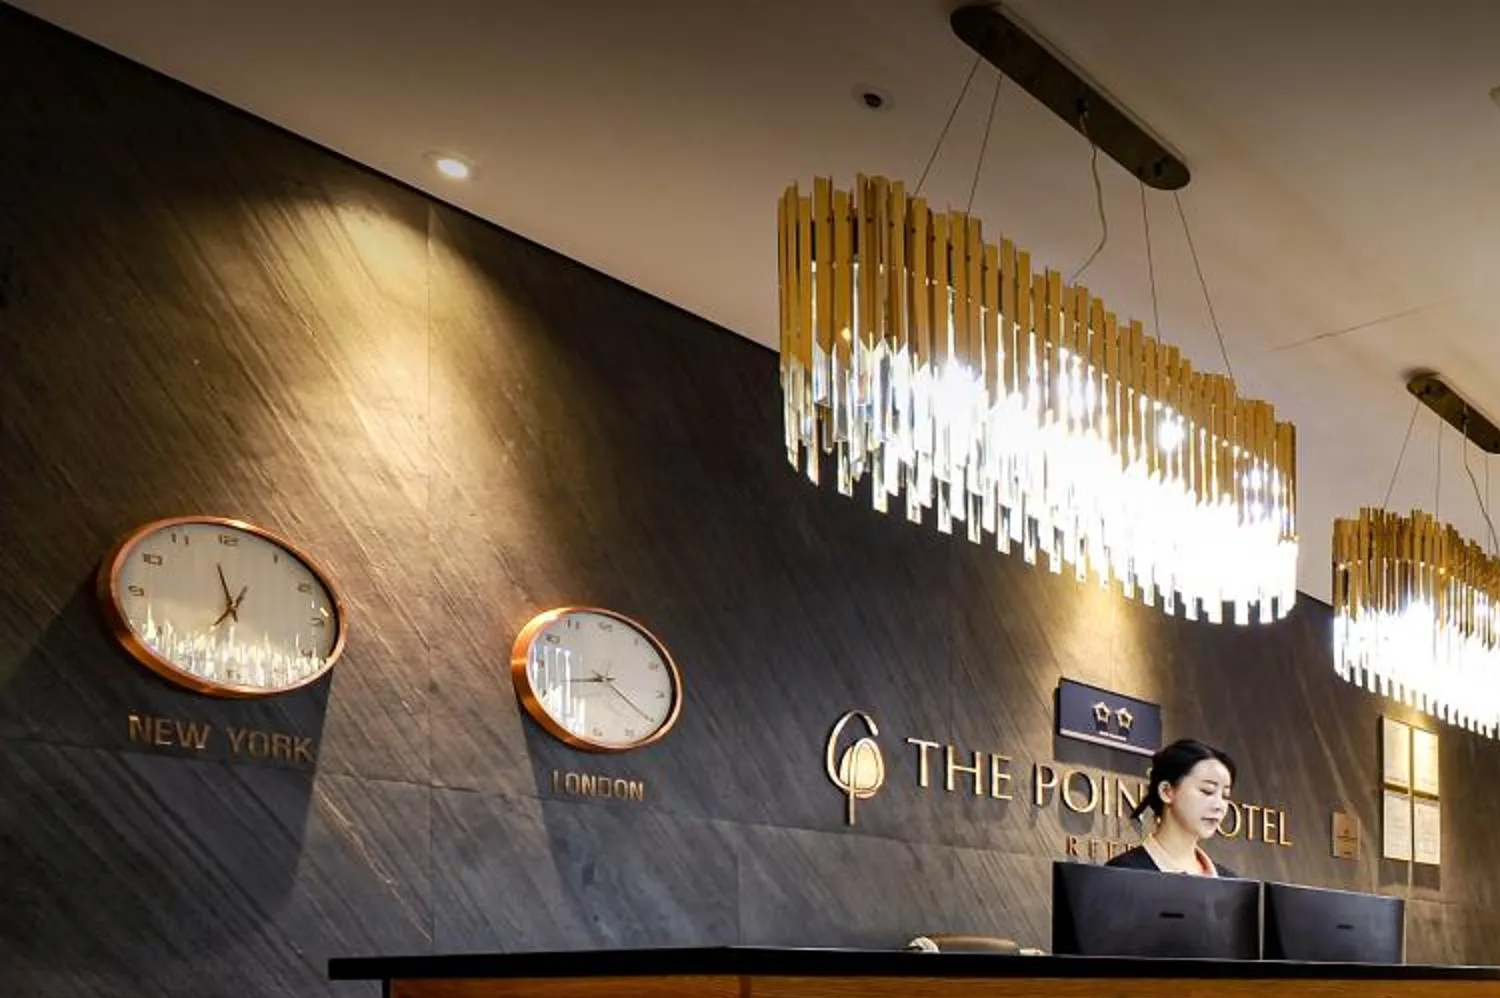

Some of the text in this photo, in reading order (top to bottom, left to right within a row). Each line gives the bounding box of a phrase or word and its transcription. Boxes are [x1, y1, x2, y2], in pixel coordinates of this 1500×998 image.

[218, 534, 240, 546] 12
[128, 712, 315, 764] NEW YORK
[552, 768, 645, 802] LONDON
[906, 737, 1294, 847] THE POIN OTEL
